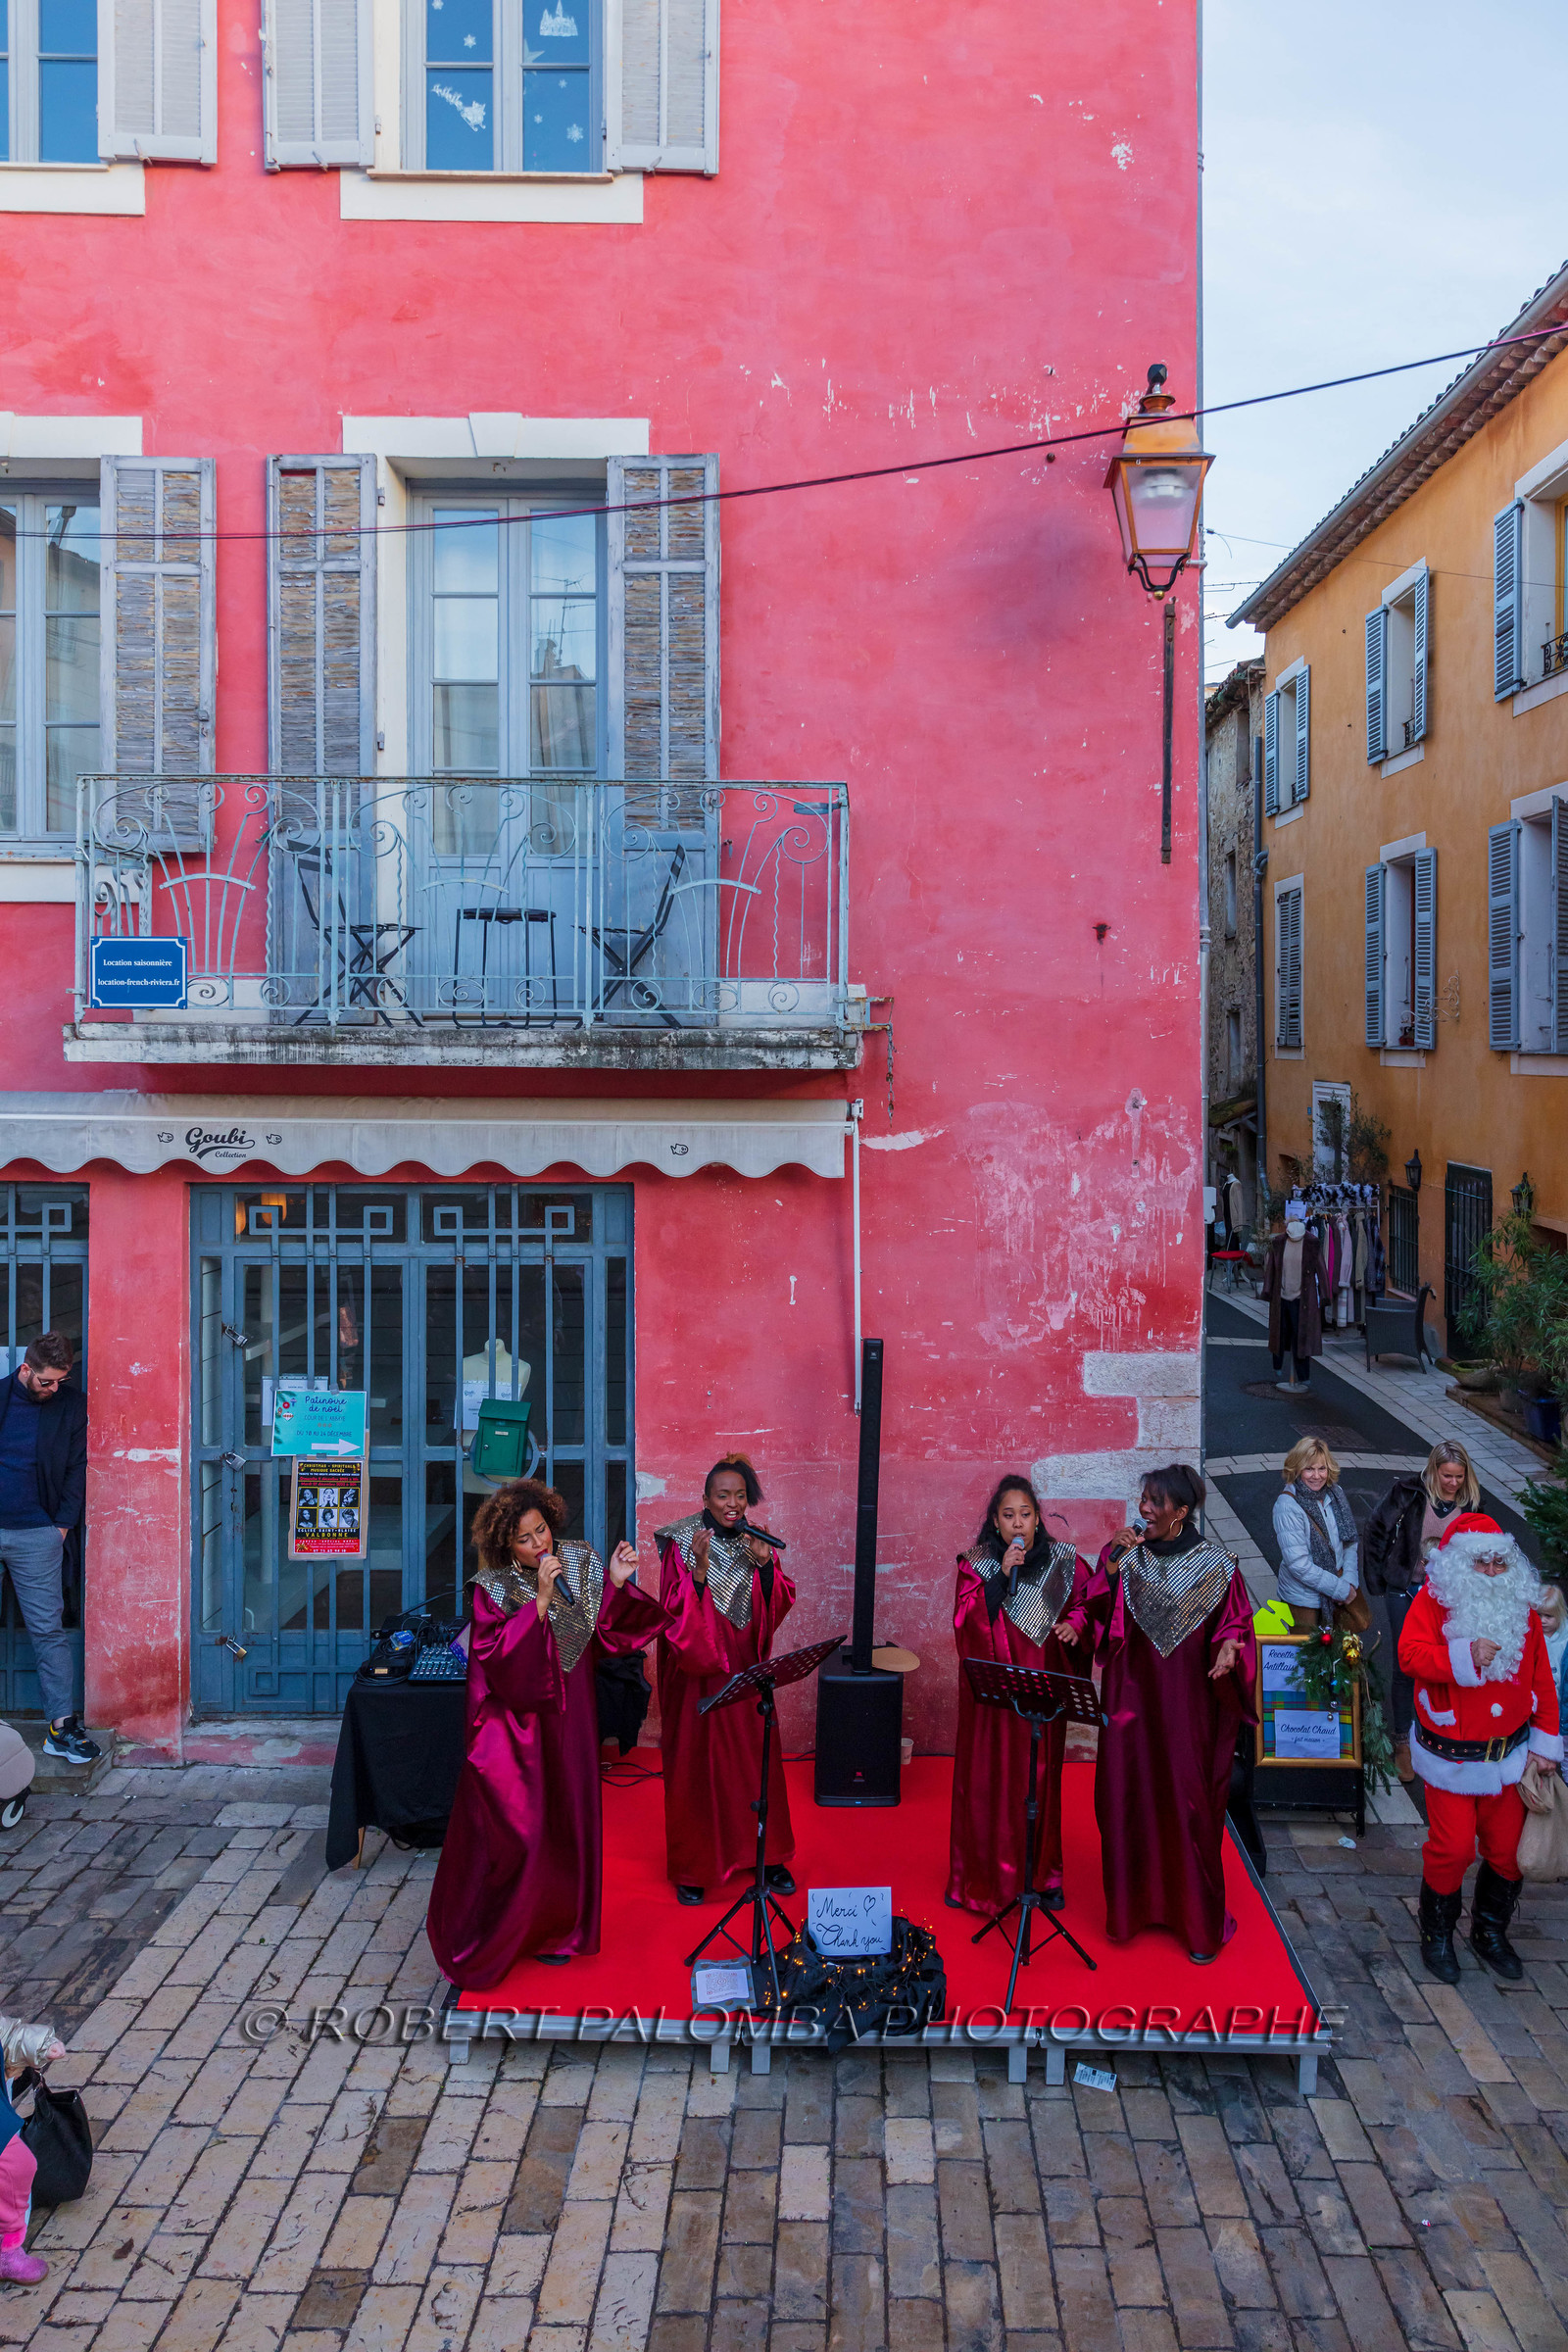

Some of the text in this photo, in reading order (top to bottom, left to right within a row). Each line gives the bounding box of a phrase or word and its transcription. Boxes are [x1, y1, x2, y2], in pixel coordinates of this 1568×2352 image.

[133, 958, 173, 967] saisonnière
[97, 977, 180, 986] location-french-riviera.fr
[185, 1127, 254, 1154] Goubi
[305, 1396, 347, 1404] Patinoire
[1280, 1724, 1337, 1736] Chocolat Chaud
[816, 1897, 858, 1918] Merci
[815, 1923, 883, 1952] Thank you
